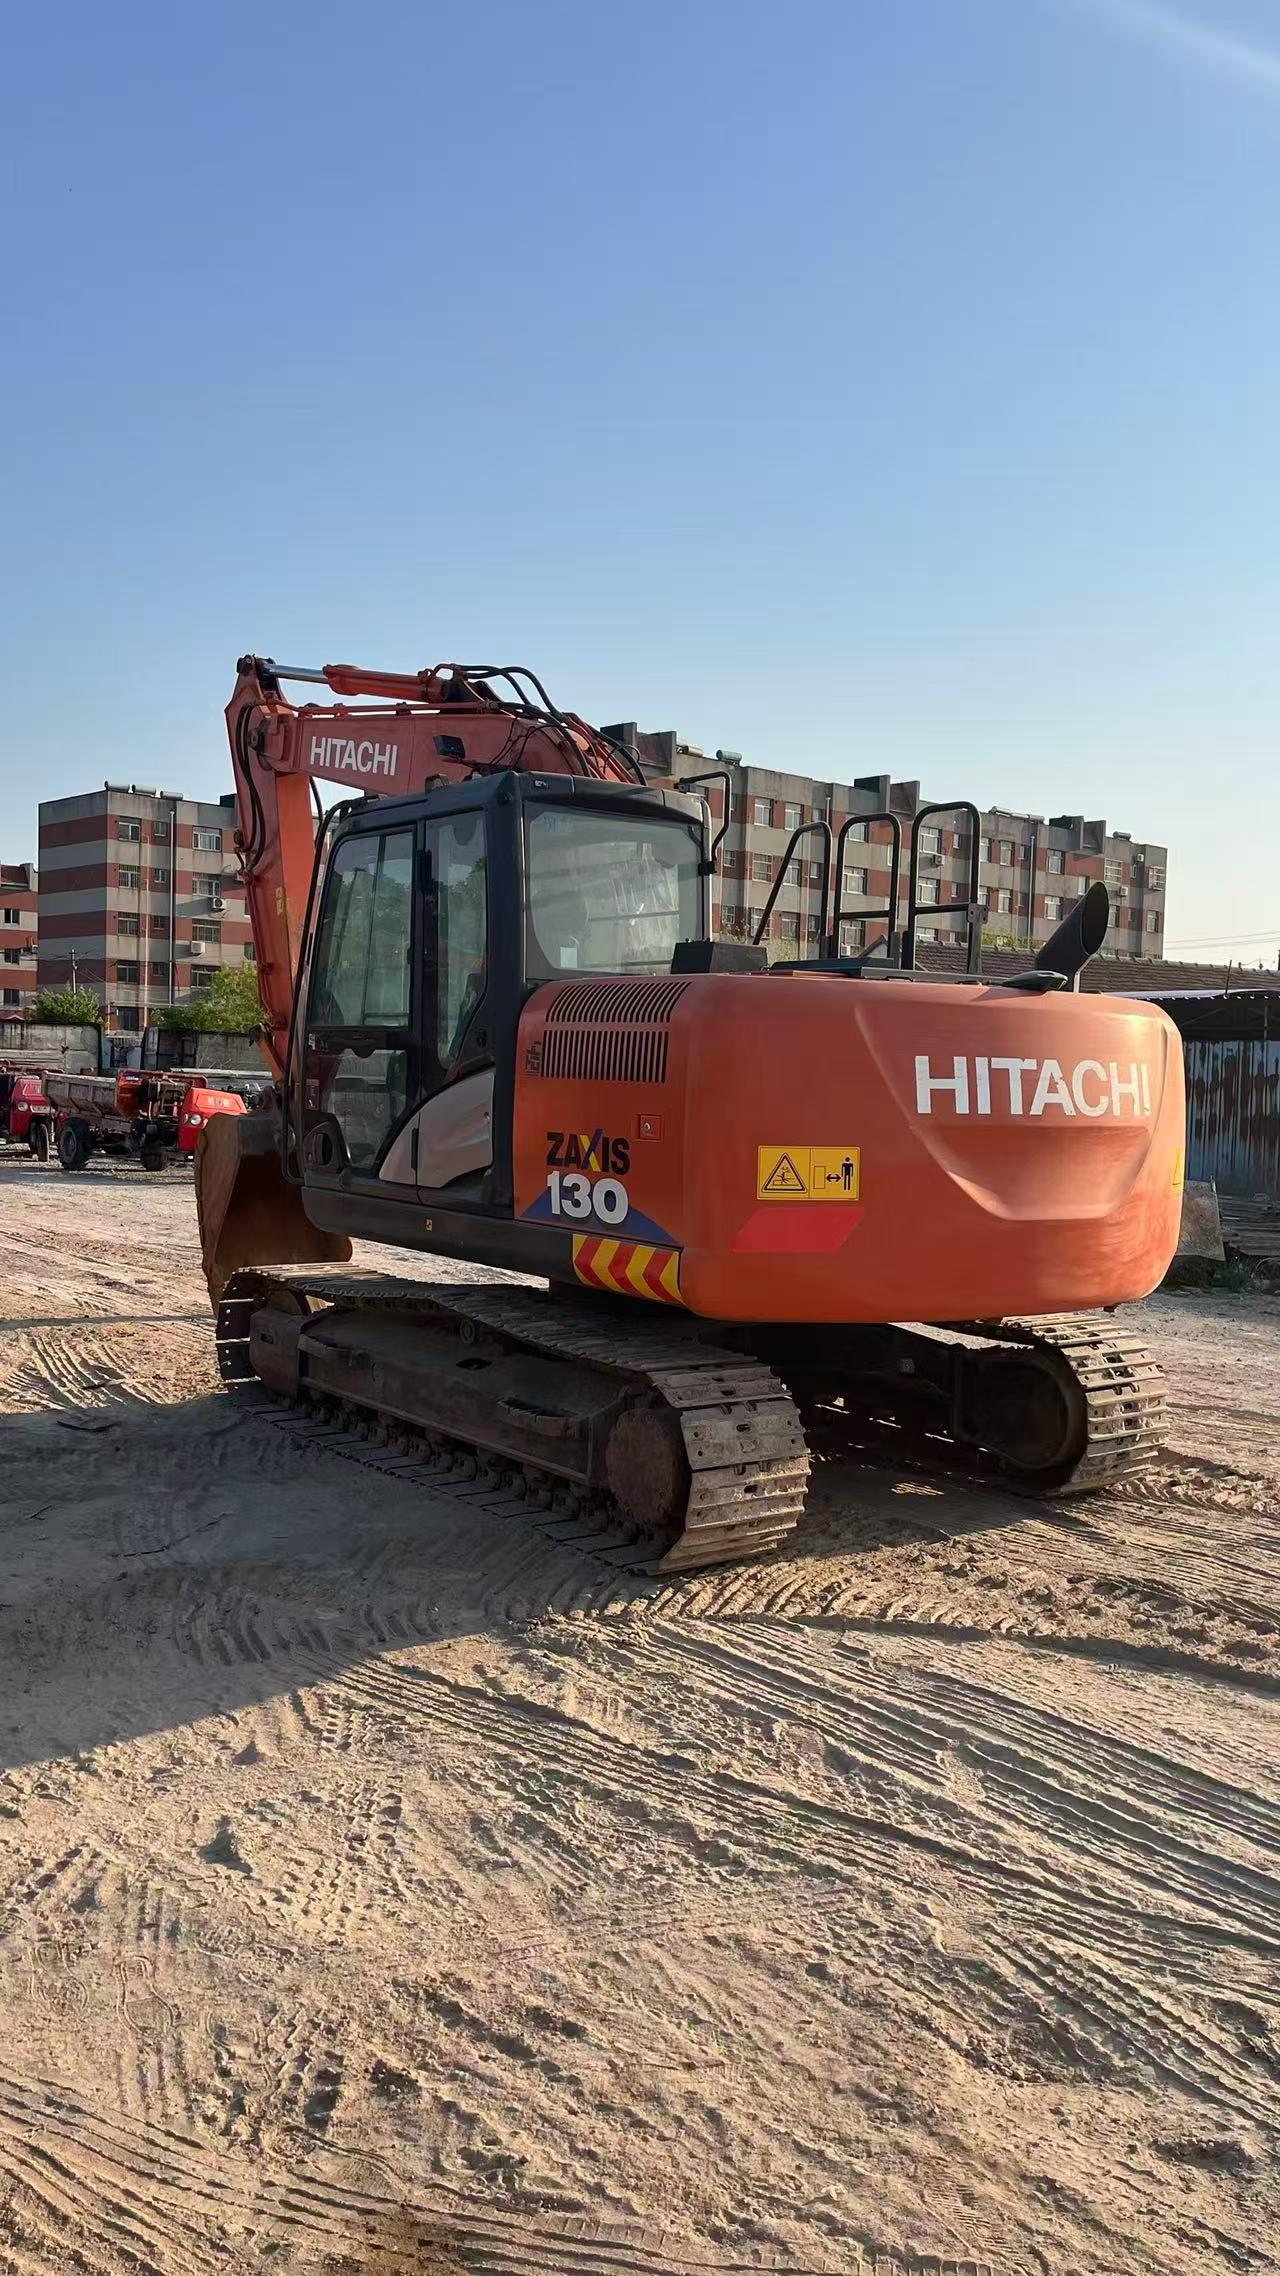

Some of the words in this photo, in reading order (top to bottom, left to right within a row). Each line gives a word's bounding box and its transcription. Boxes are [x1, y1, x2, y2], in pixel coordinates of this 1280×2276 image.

[310, 736, 398, 776] HITACHI
[915, 1055, 1151, 1117] HITACHI
[546, 1128, 630, 1176] ZAXIS
[547, 1170, 629, 1225] 130
